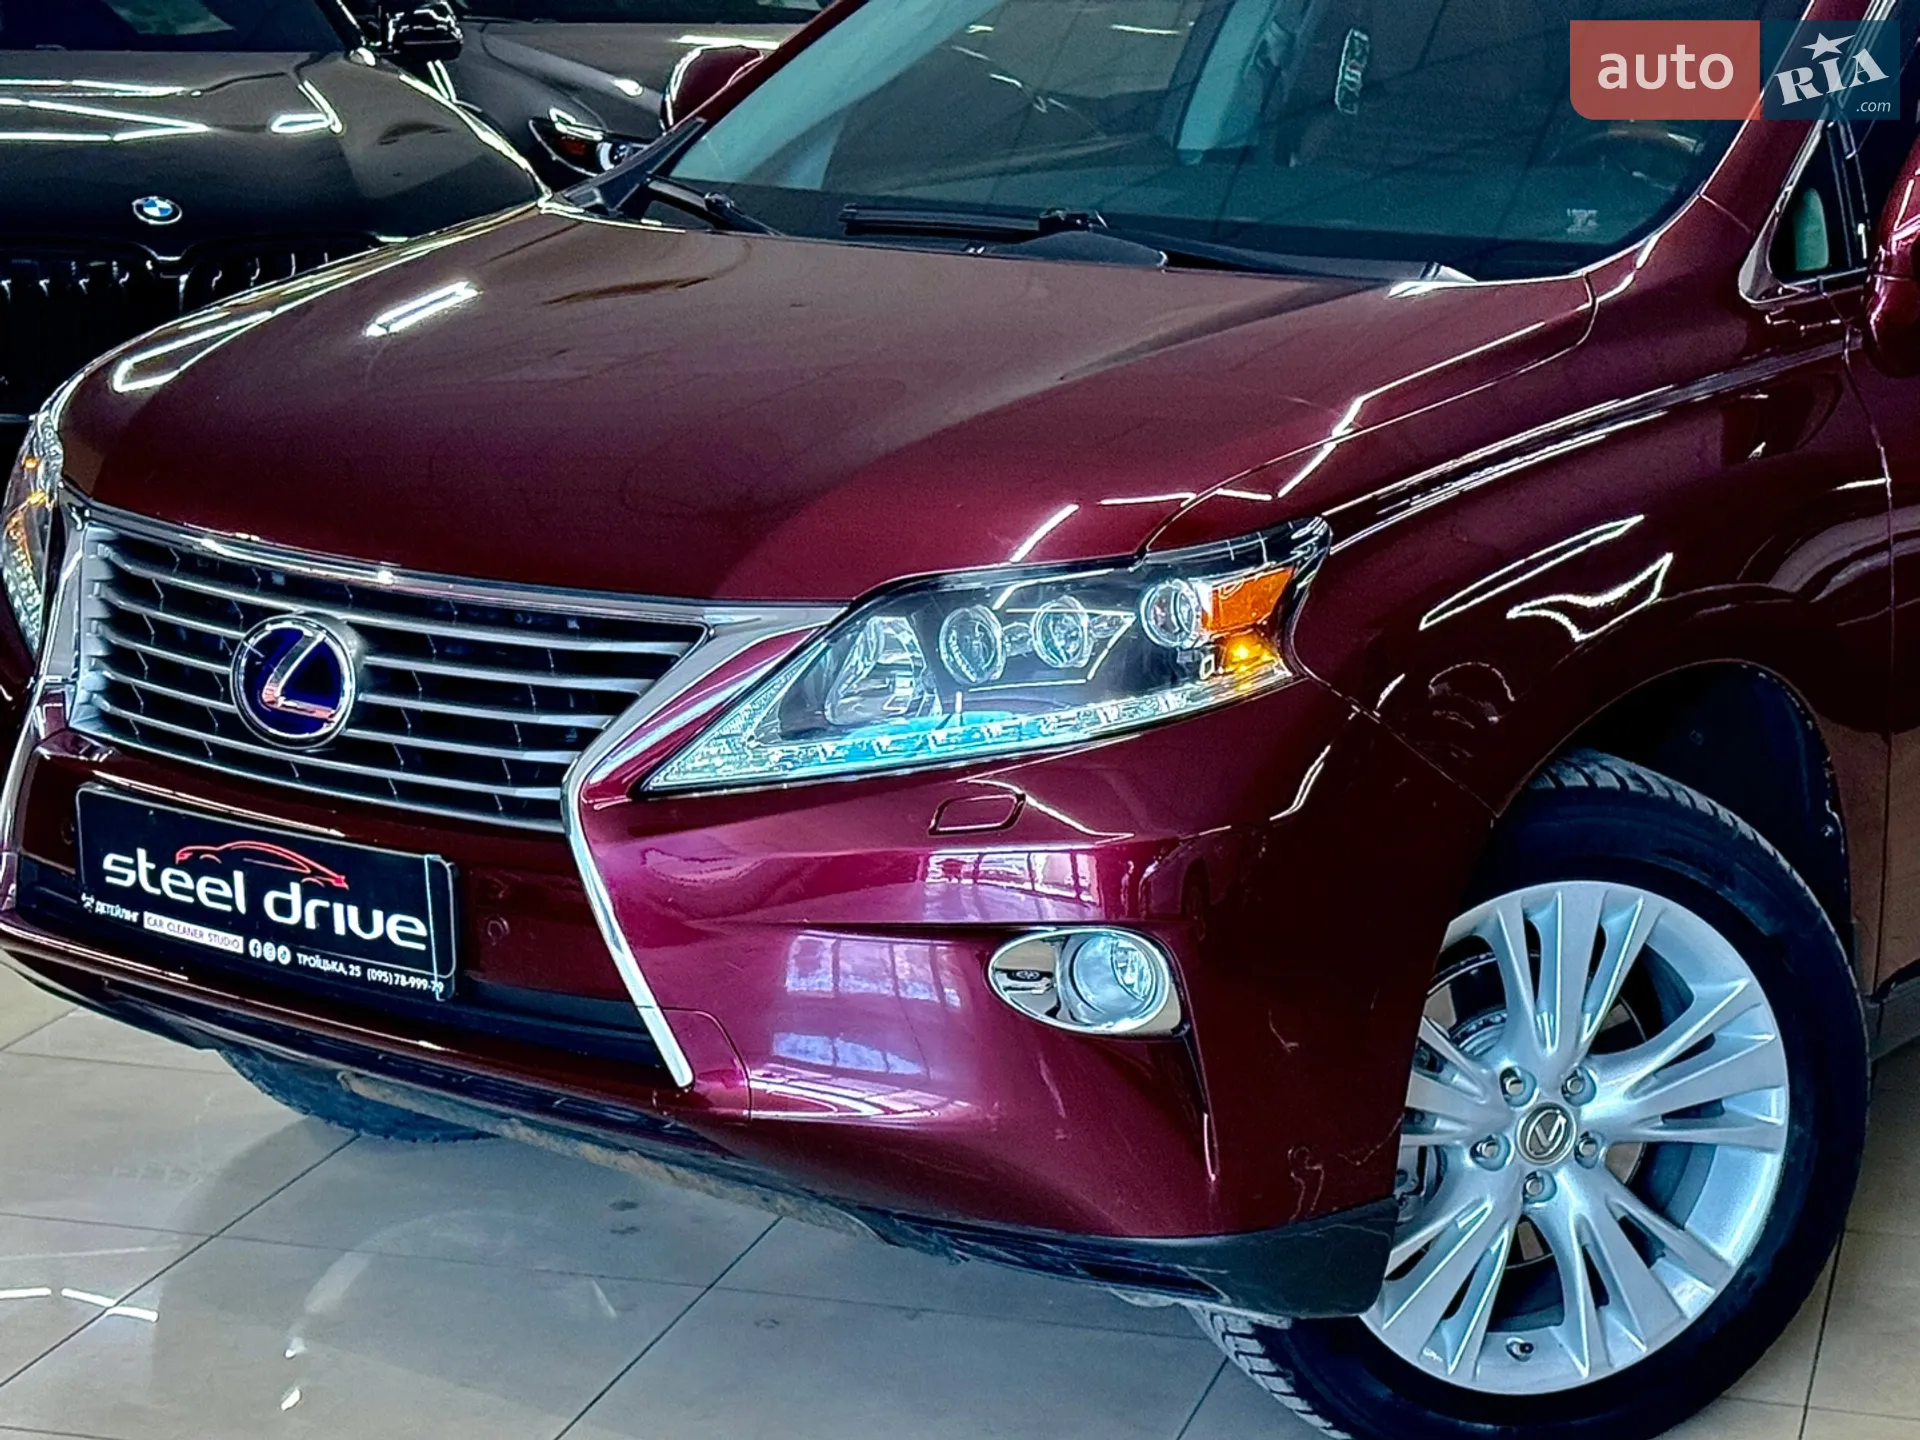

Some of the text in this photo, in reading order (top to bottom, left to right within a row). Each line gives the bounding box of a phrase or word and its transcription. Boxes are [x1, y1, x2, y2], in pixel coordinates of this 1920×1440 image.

[103, 847, 427, 951] steel drive
[146, 915, 240, 949] CAR CLEANER STUDIO
[349, 964, 361, 977] 25
